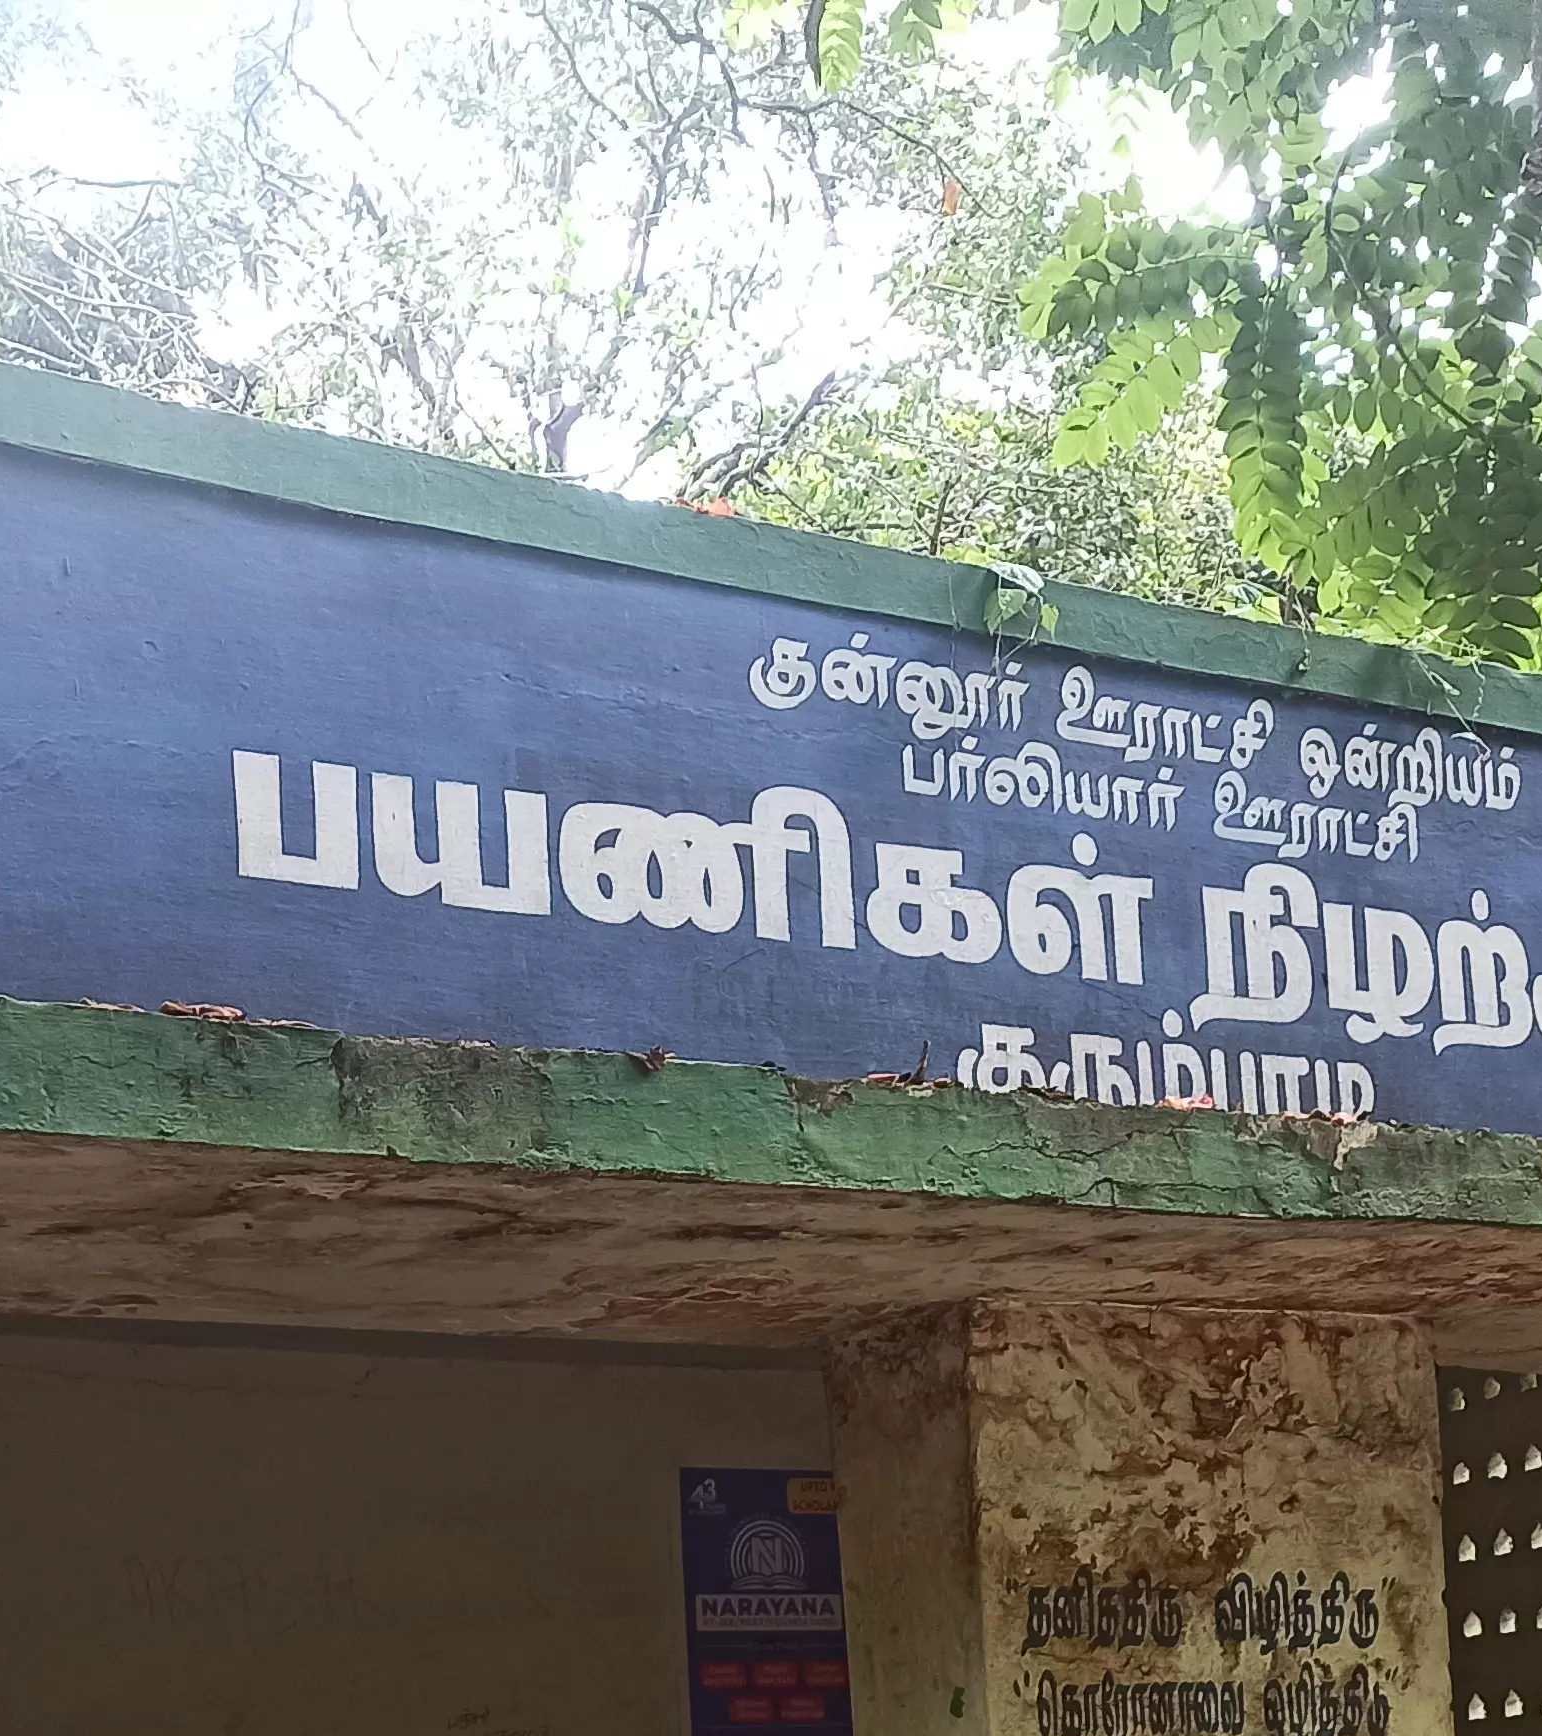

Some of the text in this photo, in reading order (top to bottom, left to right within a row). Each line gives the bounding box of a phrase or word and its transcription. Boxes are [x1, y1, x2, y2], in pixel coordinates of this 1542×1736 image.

[749, 632, 1522, 811] குன்னூர் ஊராட்சி ஒன்றியம்
[232, 748, 1155, 986] பயணிகள்
[1213, 771, 1420, 862] ஊராட்சி
[701, 1597, 836, 1617] NARAYANA
